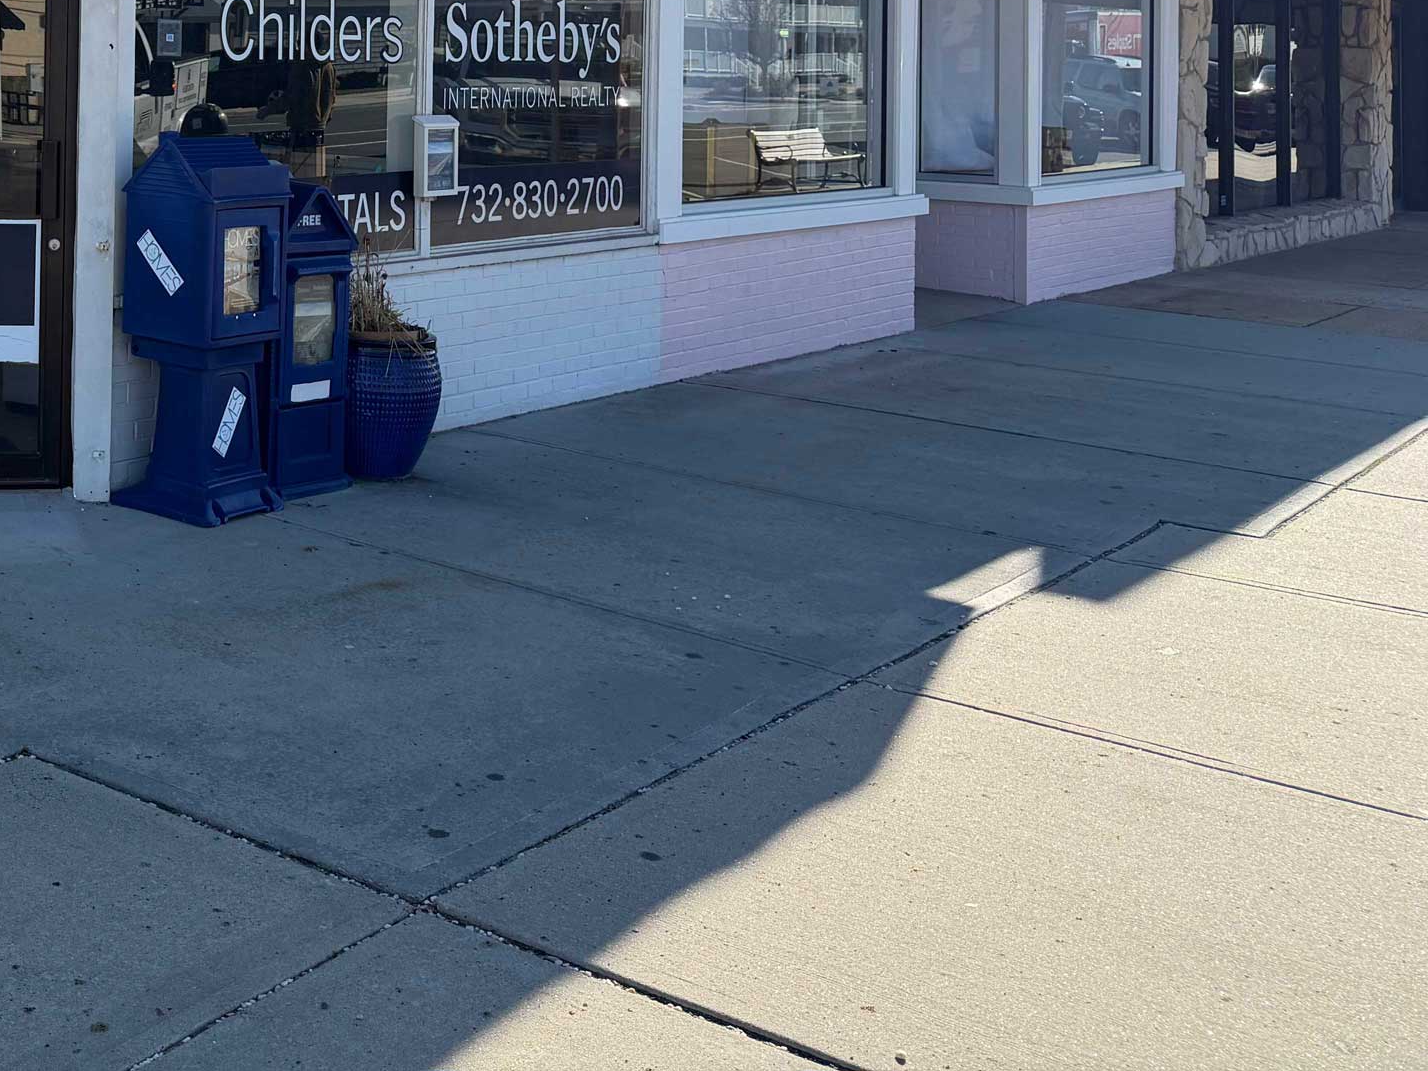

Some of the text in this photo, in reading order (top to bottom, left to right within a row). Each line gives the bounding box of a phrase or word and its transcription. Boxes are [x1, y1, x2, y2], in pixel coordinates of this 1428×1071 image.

[442, 85, 621, 110] INTERNATIONAL REALTY
[332, 189, 407, 234] TALS
[137, 230, 184, 295] HOMES
[213, 387, 246, 457] HOMES
